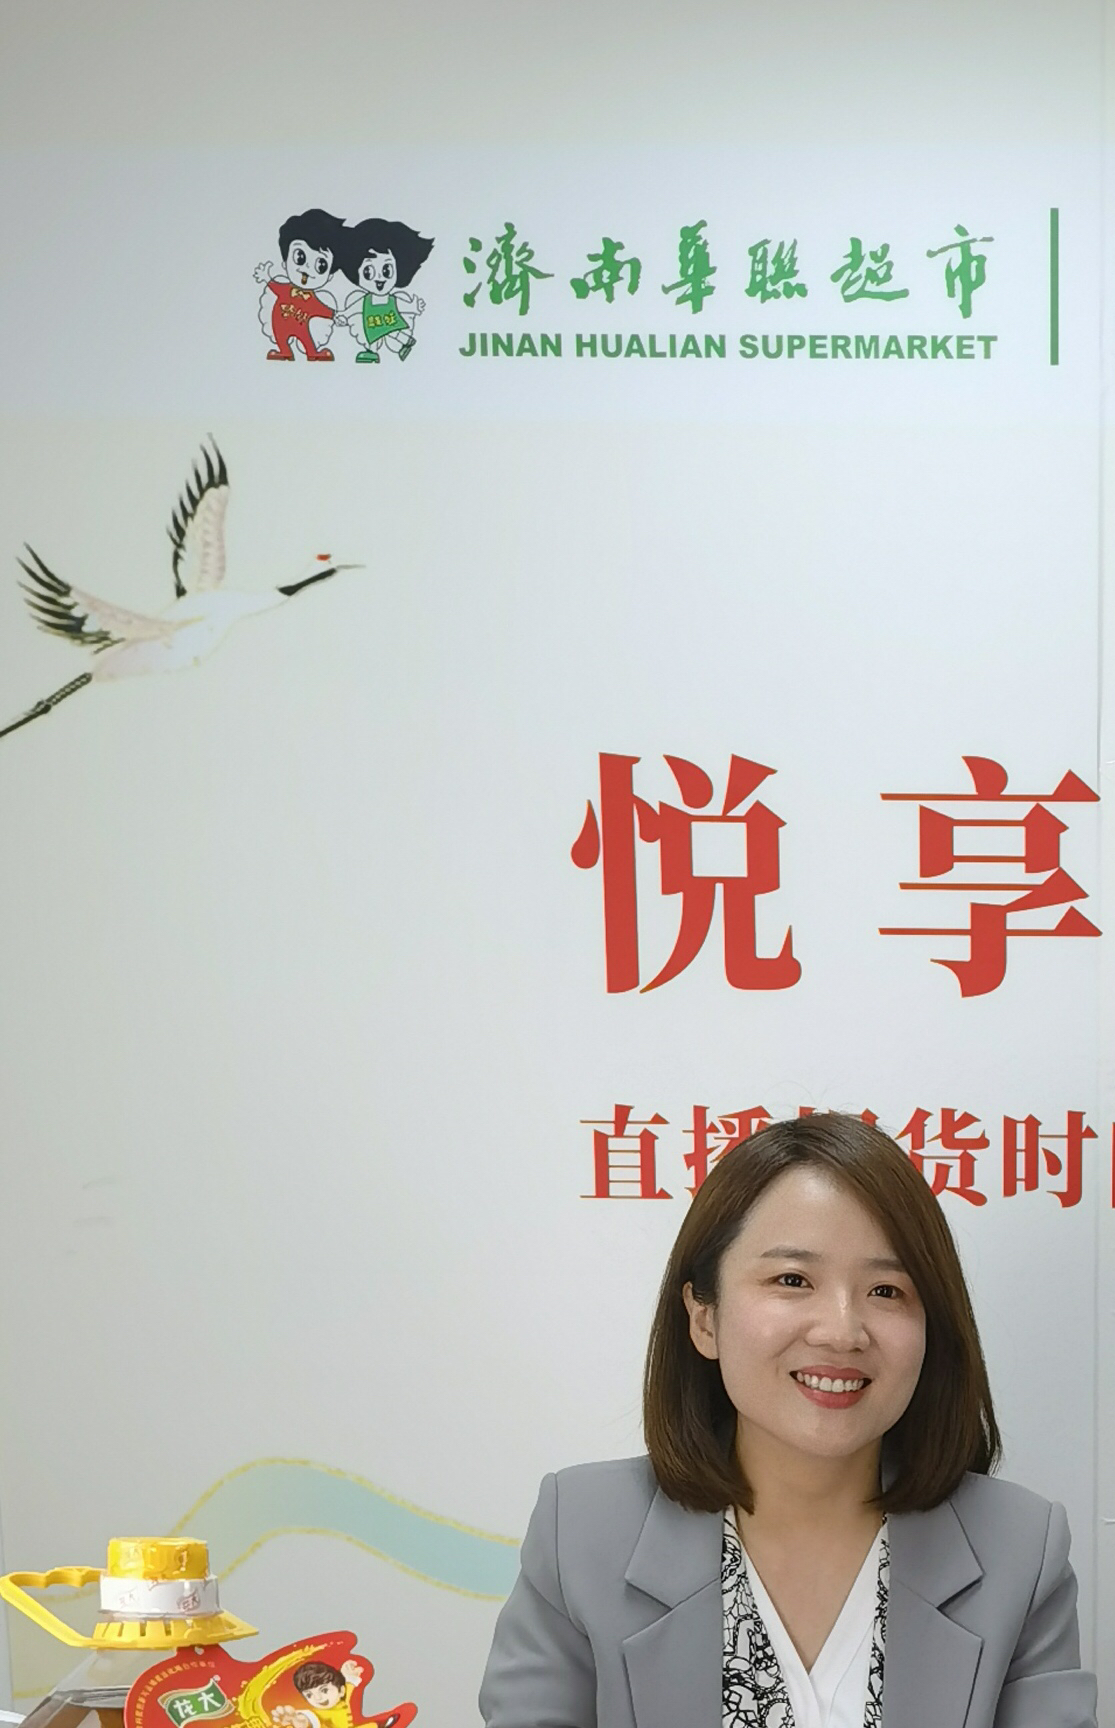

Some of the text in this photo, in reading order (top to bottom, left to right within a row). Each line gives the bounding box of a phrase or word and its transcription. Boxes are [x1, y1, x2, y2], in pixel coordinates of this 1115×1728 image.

[458, 334, 999, 360] JINAN HUALIAN SUPERMARKET
[172, 1690, 222, 1718] 龙大
